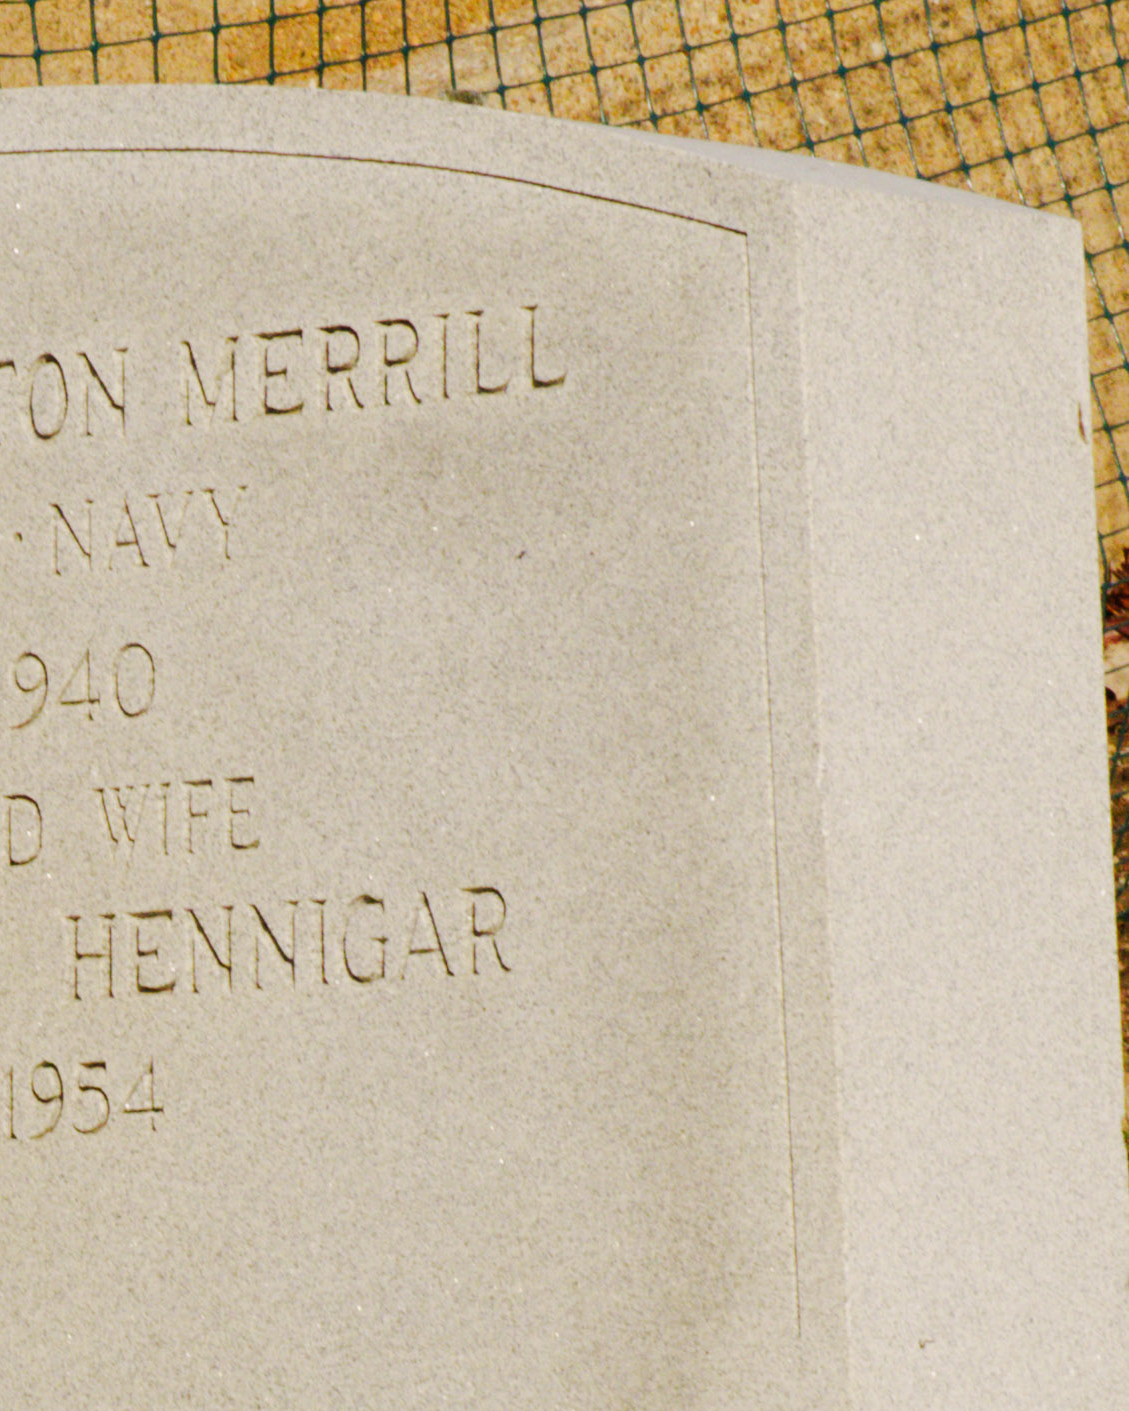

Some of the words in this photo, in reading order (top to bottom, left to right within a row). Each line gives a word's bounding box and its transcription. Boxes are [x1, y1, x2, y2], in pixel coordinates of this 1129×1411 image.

[181, 303, 568, 427] MERRILL
[50, 484, 248, 577] NAVY
[94, 775, 262, 857] WIFE
[64, 885, 513, 1002] HENNIGAR
[6, 1058, 165, 1142] 1954
